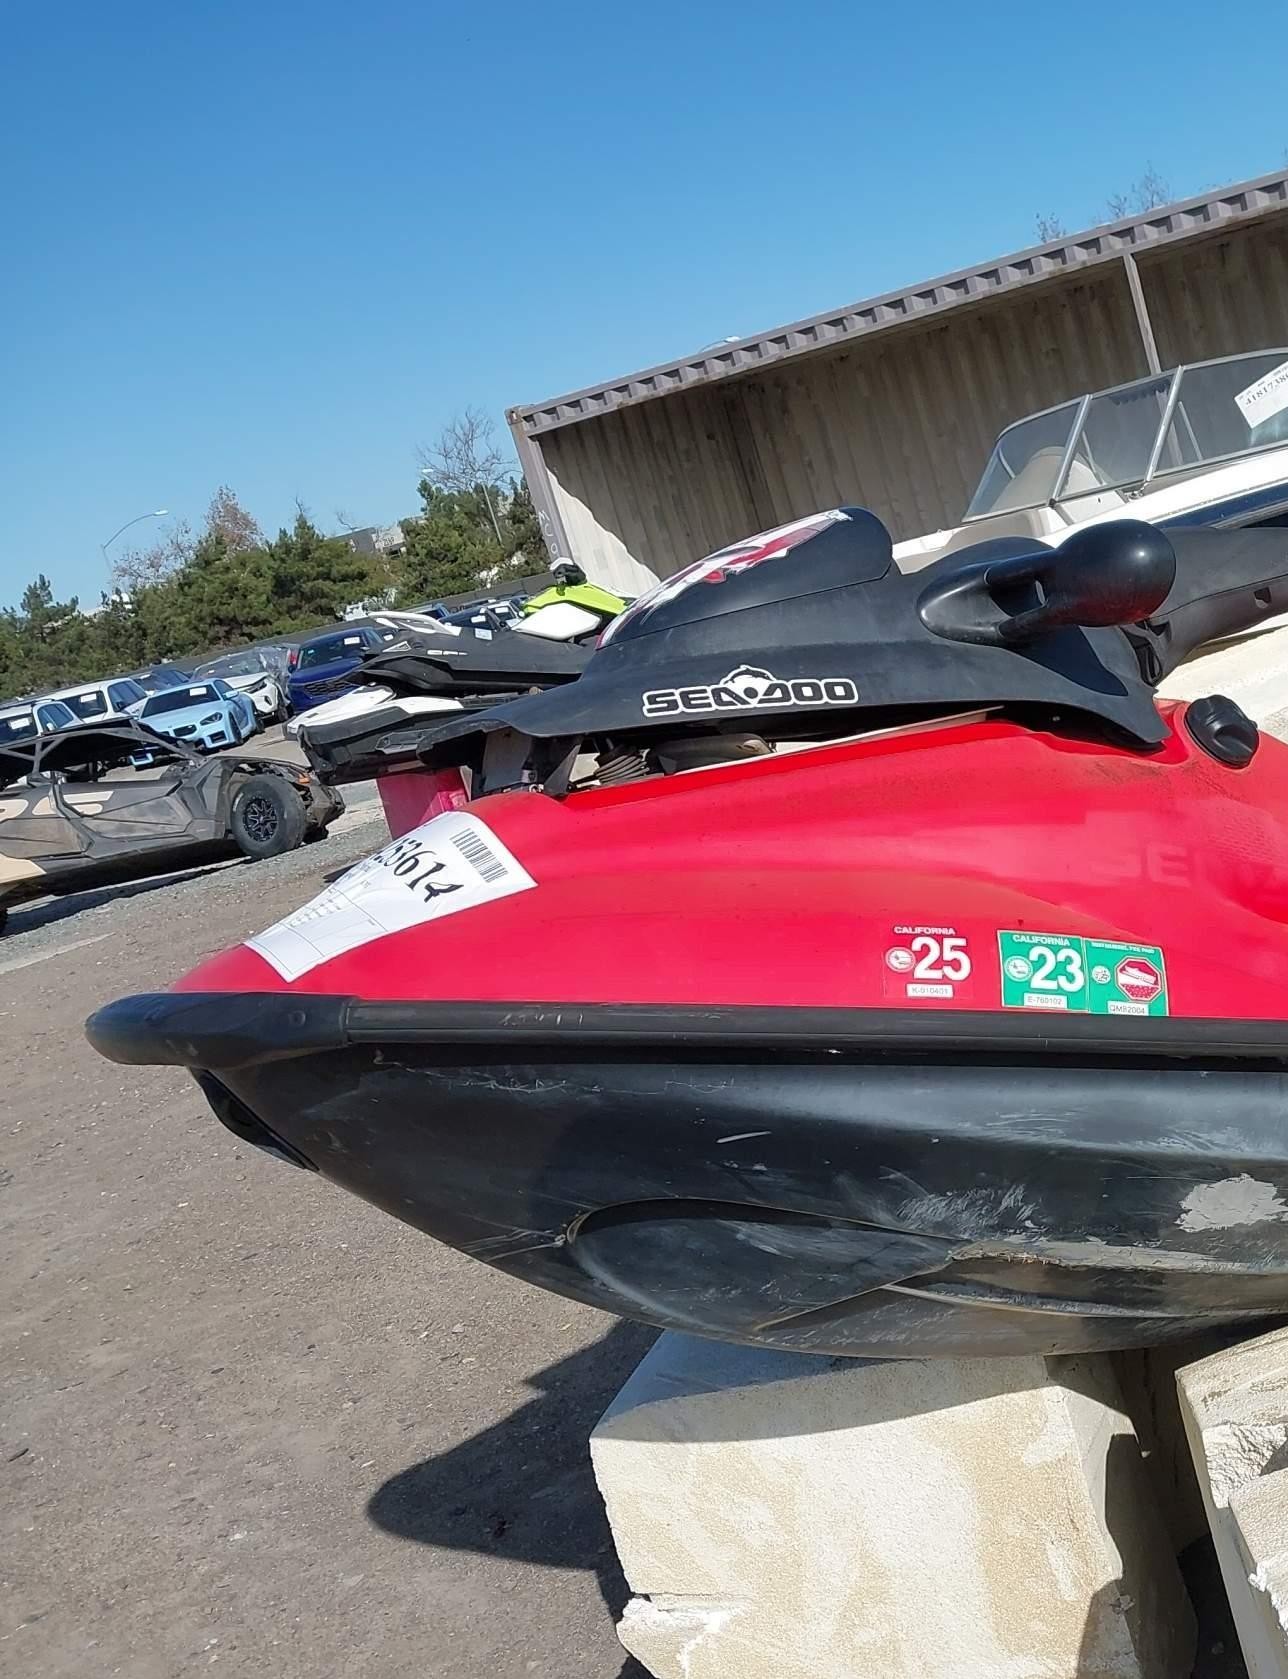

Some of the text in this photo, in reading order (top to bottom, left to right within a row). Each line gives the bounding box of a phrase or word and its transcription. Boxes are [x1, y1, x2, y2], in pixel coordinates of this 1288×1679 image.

[893, 926, 956, 936] CALIFORNIA
[1012, 934, 1071, 947] CALIFORNIA
[911, 936, 972, 981] 25
[1028, 945, 1086, 993] 23
